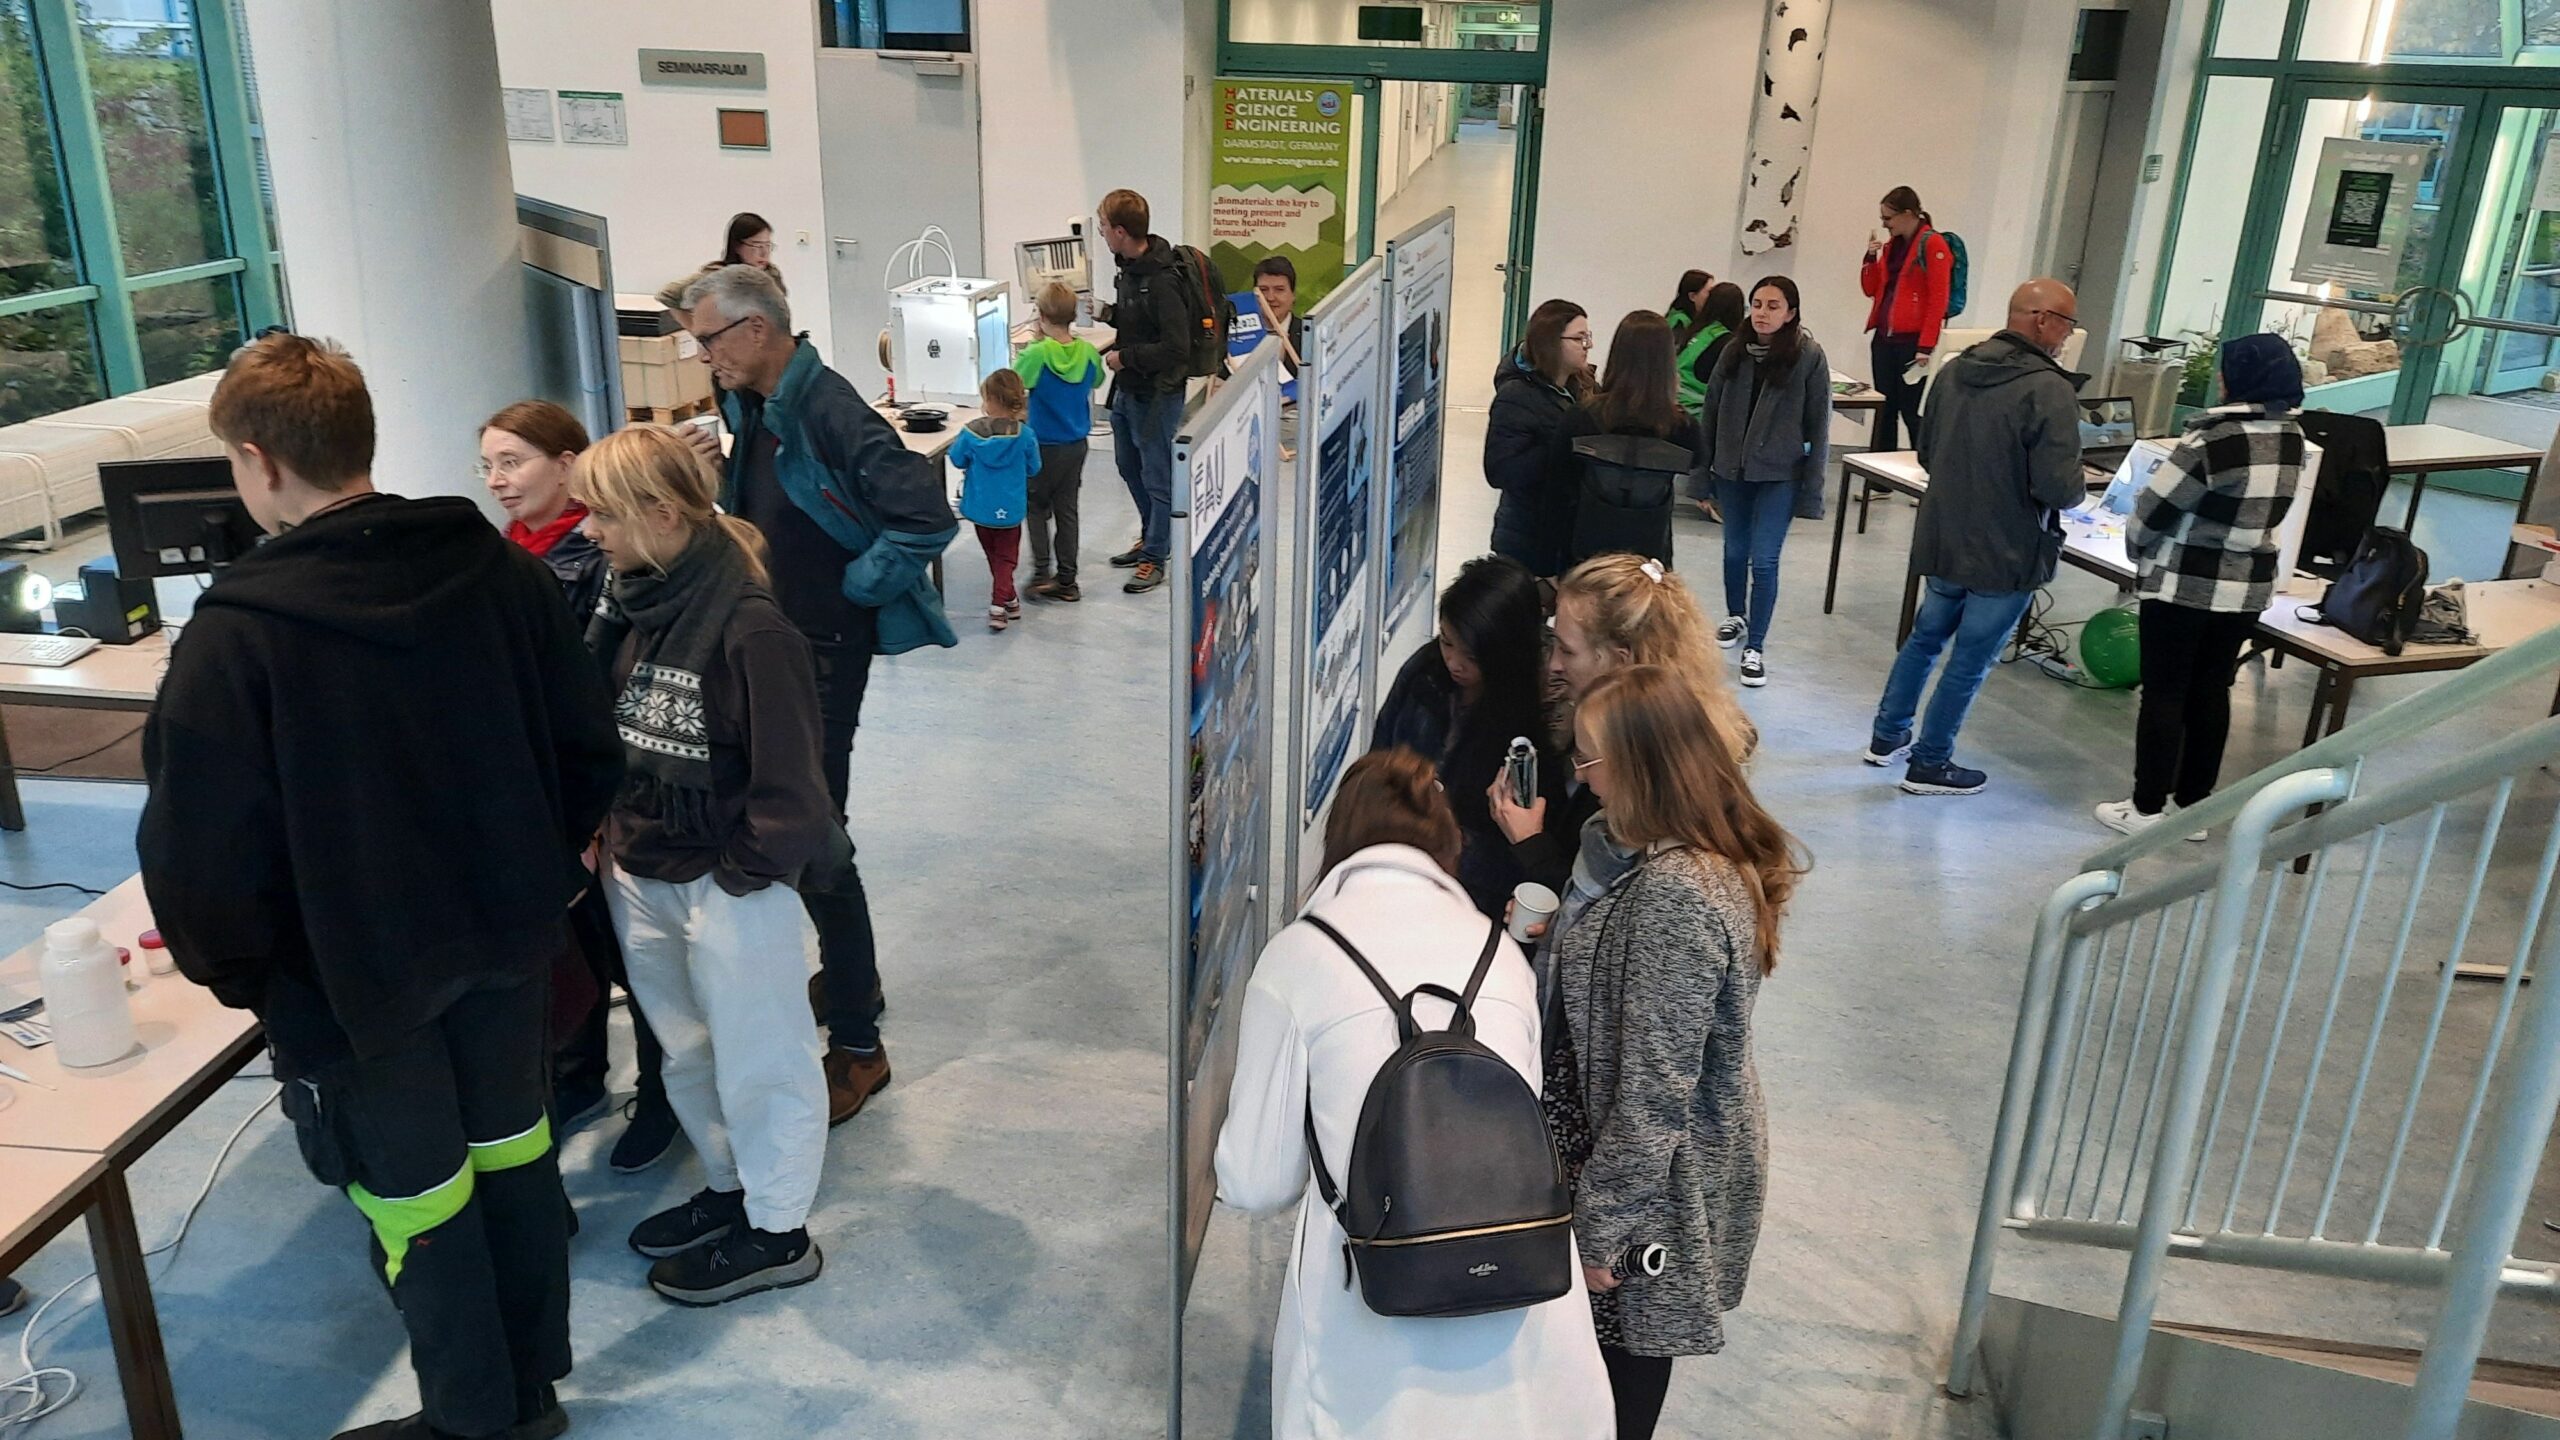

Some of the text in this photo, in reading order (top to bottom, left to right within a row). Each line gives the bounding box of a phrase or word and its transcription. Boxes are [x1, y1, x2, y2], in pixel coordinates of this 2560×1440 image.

[657, 60, 748, 76] SEMINARRAUM
[1224, 87, 1314, 102] MATERIALS
[1224, 103, 1298, 118] SCIENCE
[1224, 118, 1341, 134] ENGINEERING
[1223, 138, 1340, 151] DARMSTADT, GERMANY
[1223, 156, 1340, 168] www.mse-congress.de
[1276, 198, 1290, 207] the
[1292, 199, 1307, 209] key
[1310, 200, 1320, 208] to
[1212, 207, 1301, 218] meeting present and
[1212, 218, 1287, 228] future healthcare
[1194, 436, 1225, 536] FAU
